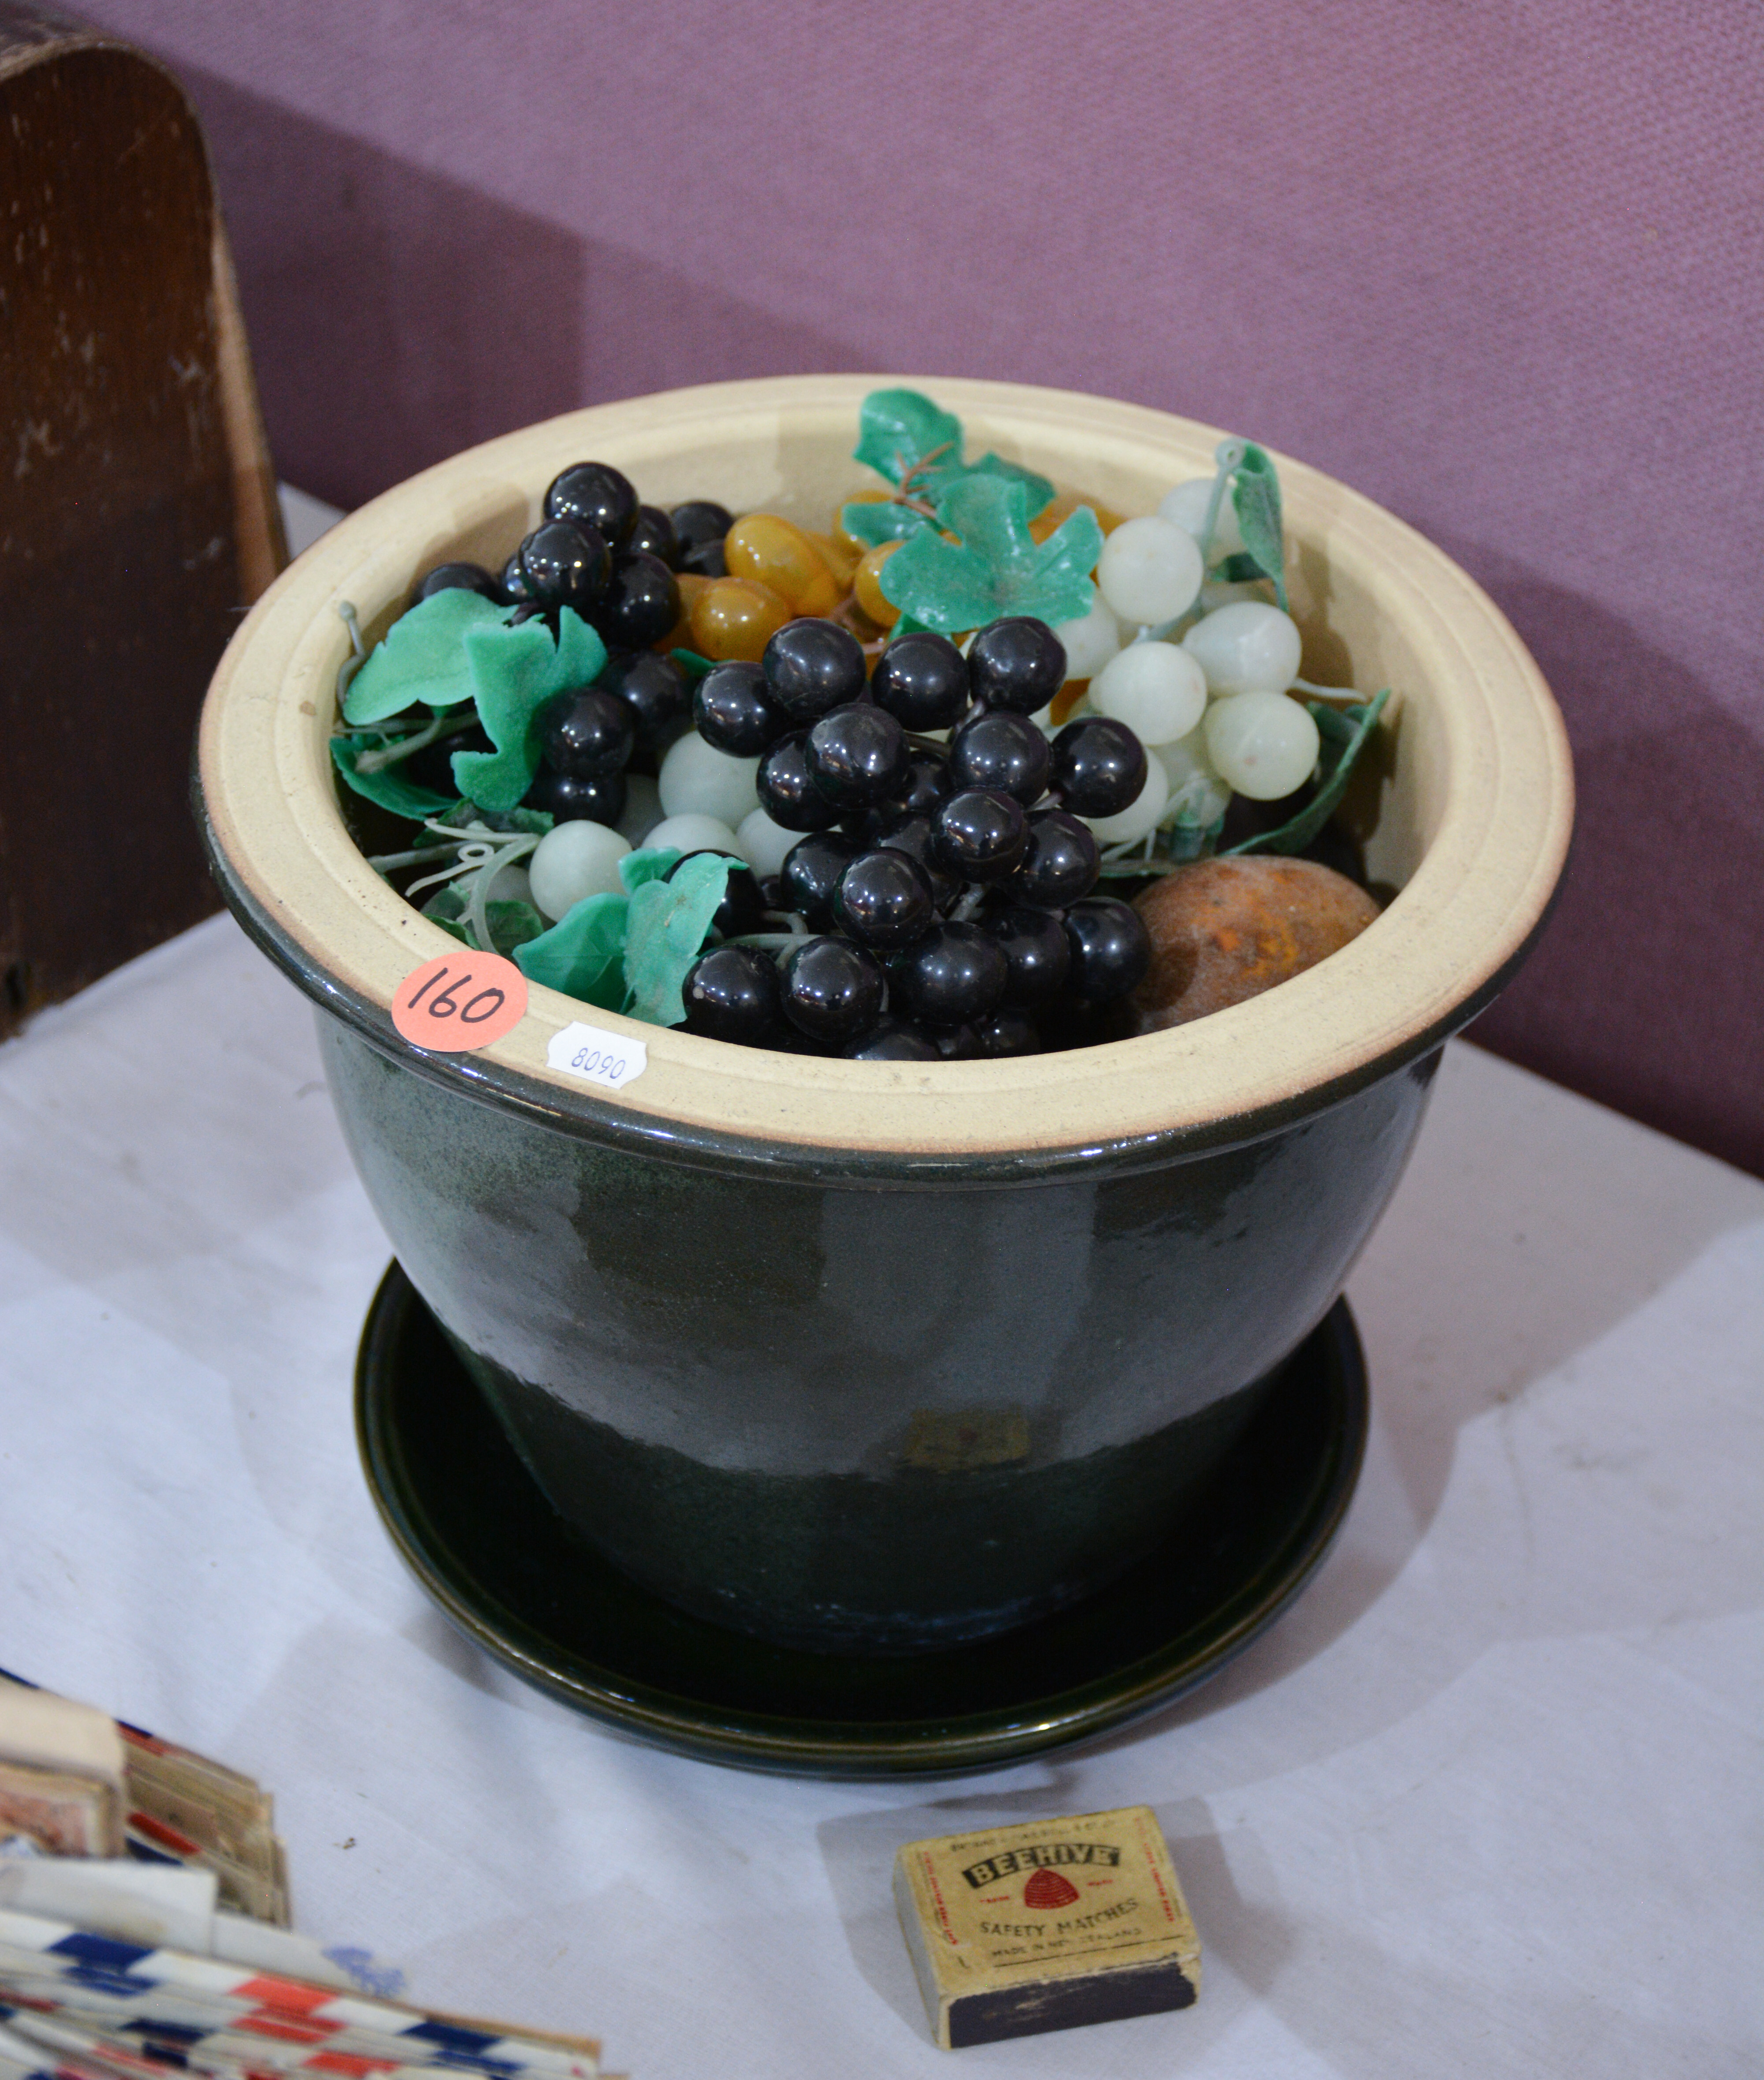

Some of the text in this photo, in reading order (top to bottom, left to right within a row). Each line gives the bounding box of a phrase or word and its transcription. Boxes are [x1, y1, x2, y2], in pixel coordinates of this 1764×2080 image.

[408, 967, 505, 1023] 160
[571, 1047, 626, 1079] 8090
[970, 1844, 1113, 1887] BEEHIVE
[979, 1897, 1139, 1937] SAFETY MATCHES
